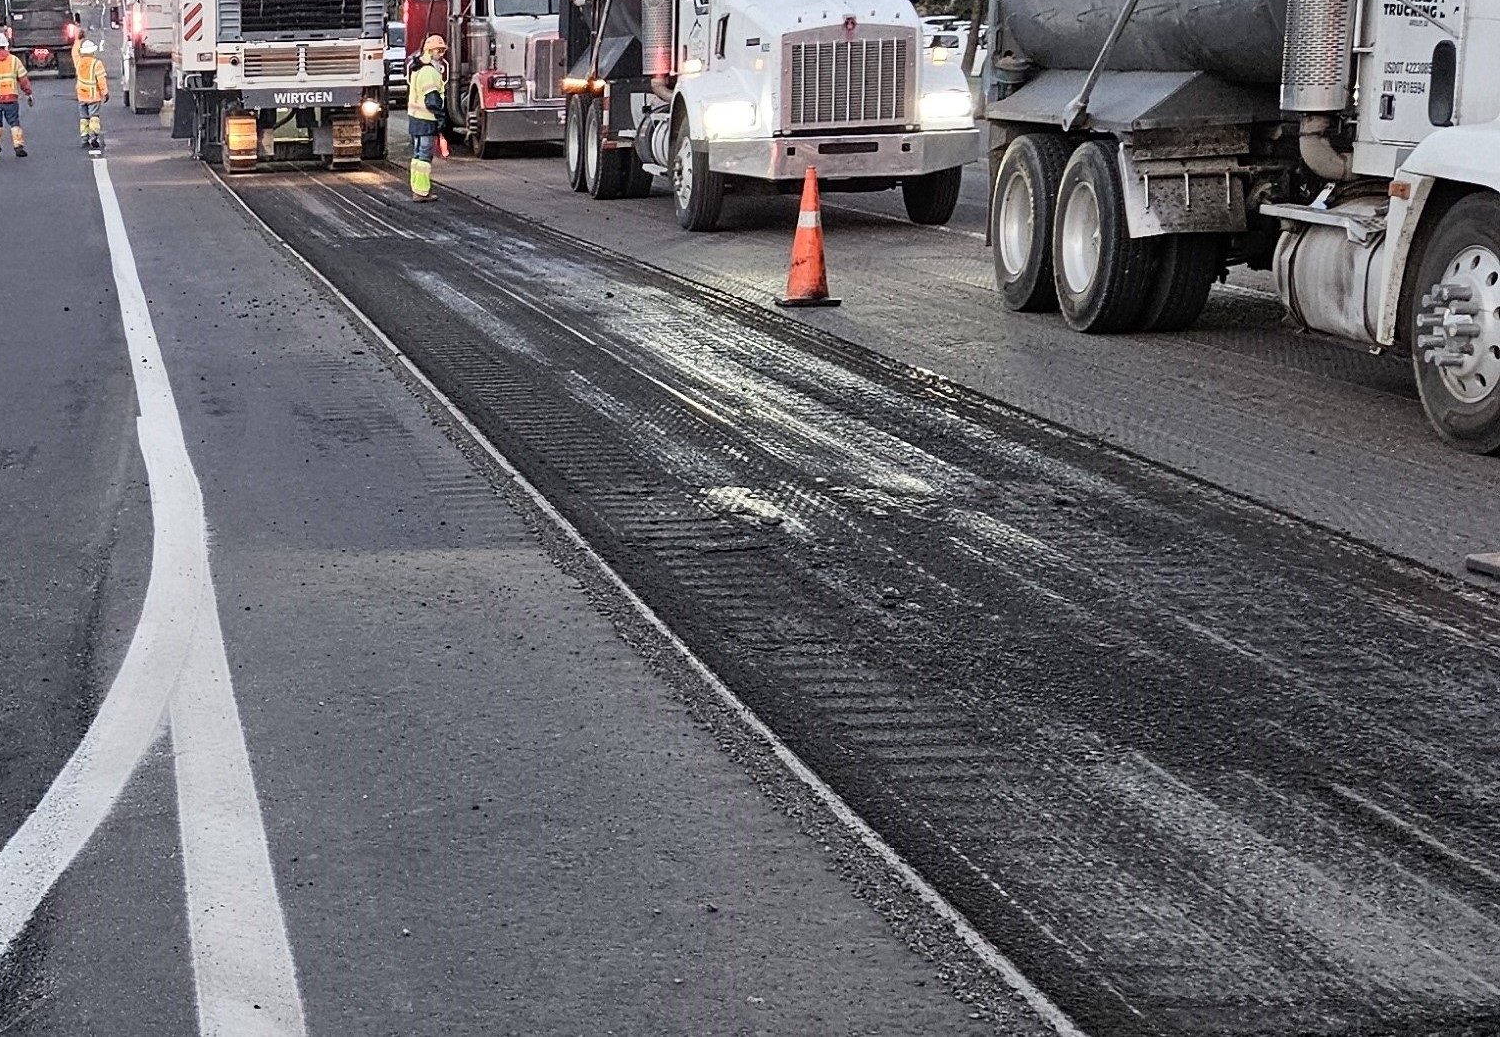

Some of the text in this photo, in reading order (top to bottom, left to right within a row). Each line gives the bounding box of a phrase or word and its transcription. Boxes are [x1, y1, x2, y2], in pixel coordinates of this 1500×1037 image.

[1383, 3, 1438, 19] TRUCKING
[1384, 62, 1404, 74] USDOT
[274, 91, 333, 103] WIRTGEN
